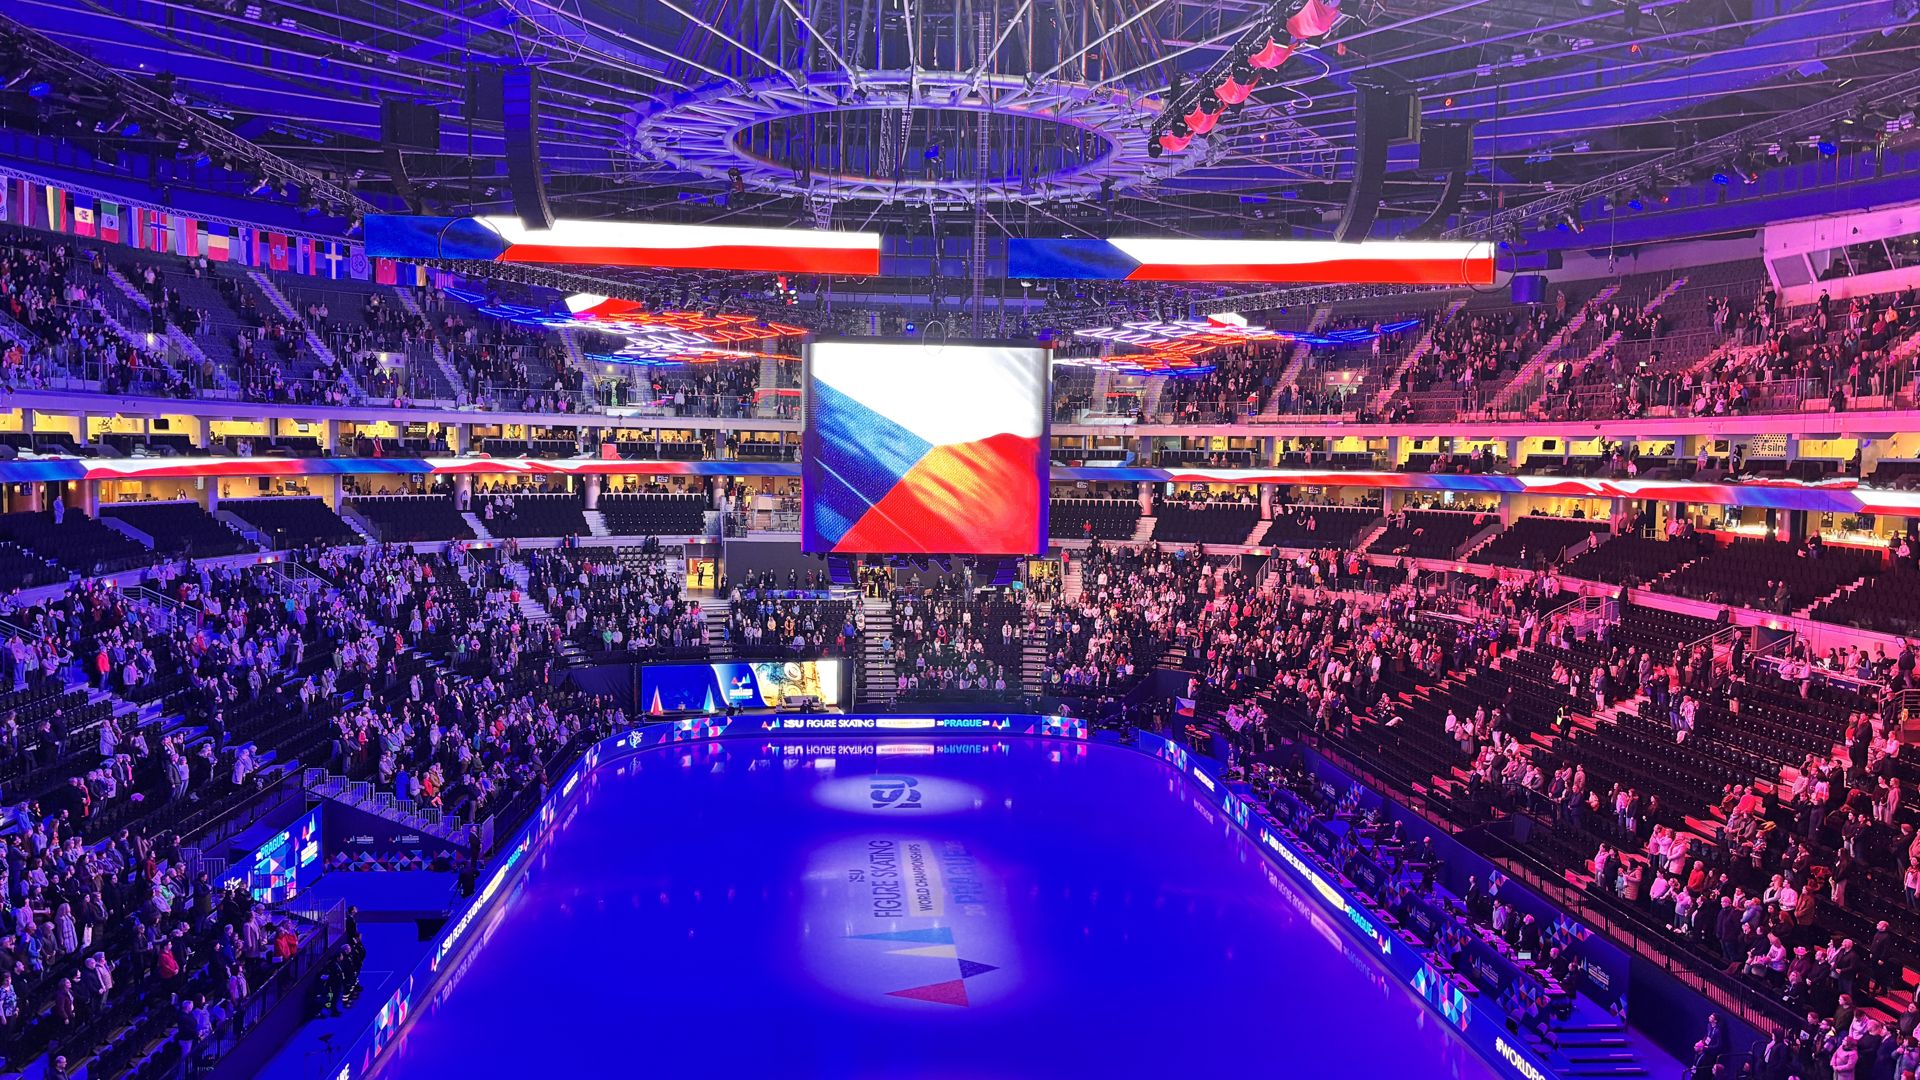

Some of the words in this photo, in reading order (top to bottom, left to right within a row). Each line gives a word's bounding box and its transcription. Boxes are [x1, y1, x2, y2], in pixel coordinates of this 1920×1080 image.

[783, 719, 804, 728] ISU
[806, 719, 836, 728] FIGURE
[838, 719, 875, 728] SKATING
[869, 775, 922, 808] ISU
[869, 840, 898, 878] SKATING
[908, 843, 928, 887] CHAMPIONSHIPS
[872, 880, 903, 918] FIGURE
[916, 887, 934, 912] WORLD
